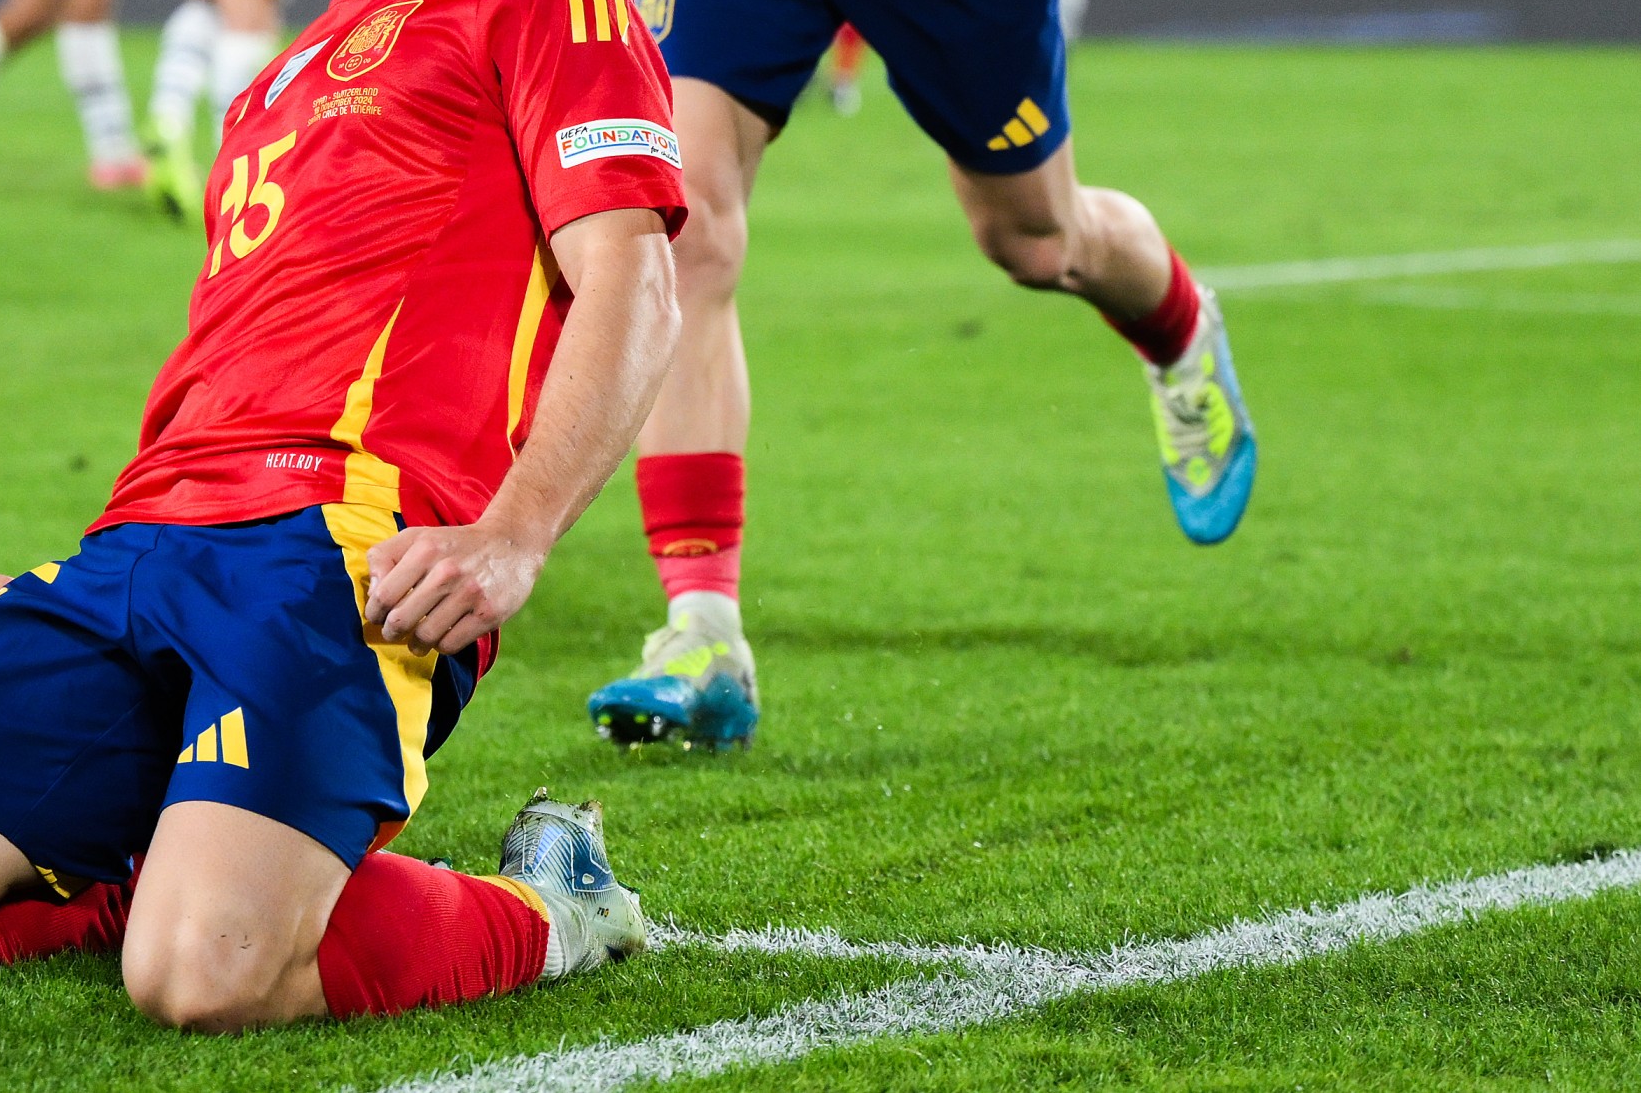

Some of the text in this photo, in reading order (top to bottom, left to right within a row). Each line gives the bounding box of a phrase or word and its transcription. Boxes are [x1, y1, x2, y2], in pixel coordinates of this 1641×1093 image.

[333, 87, 379, 100] SWITZERLAND
[321, 97, 352, 112] NOVEMBER
[353, 96, 373, 105] 2024
[322, 108, 338, 119] CRUZ
[339, 106, 348, 116] DE
[350, 105, 382, 115] TENERIFE
[560, 126, 588, 140] UEFA
[562, 129, 678, 155] FOUNDATION
[650, 146, 659, 154] for
[207, 130, 297, 280] 15
[265, 453, 323, 472] HEAT.RDY
